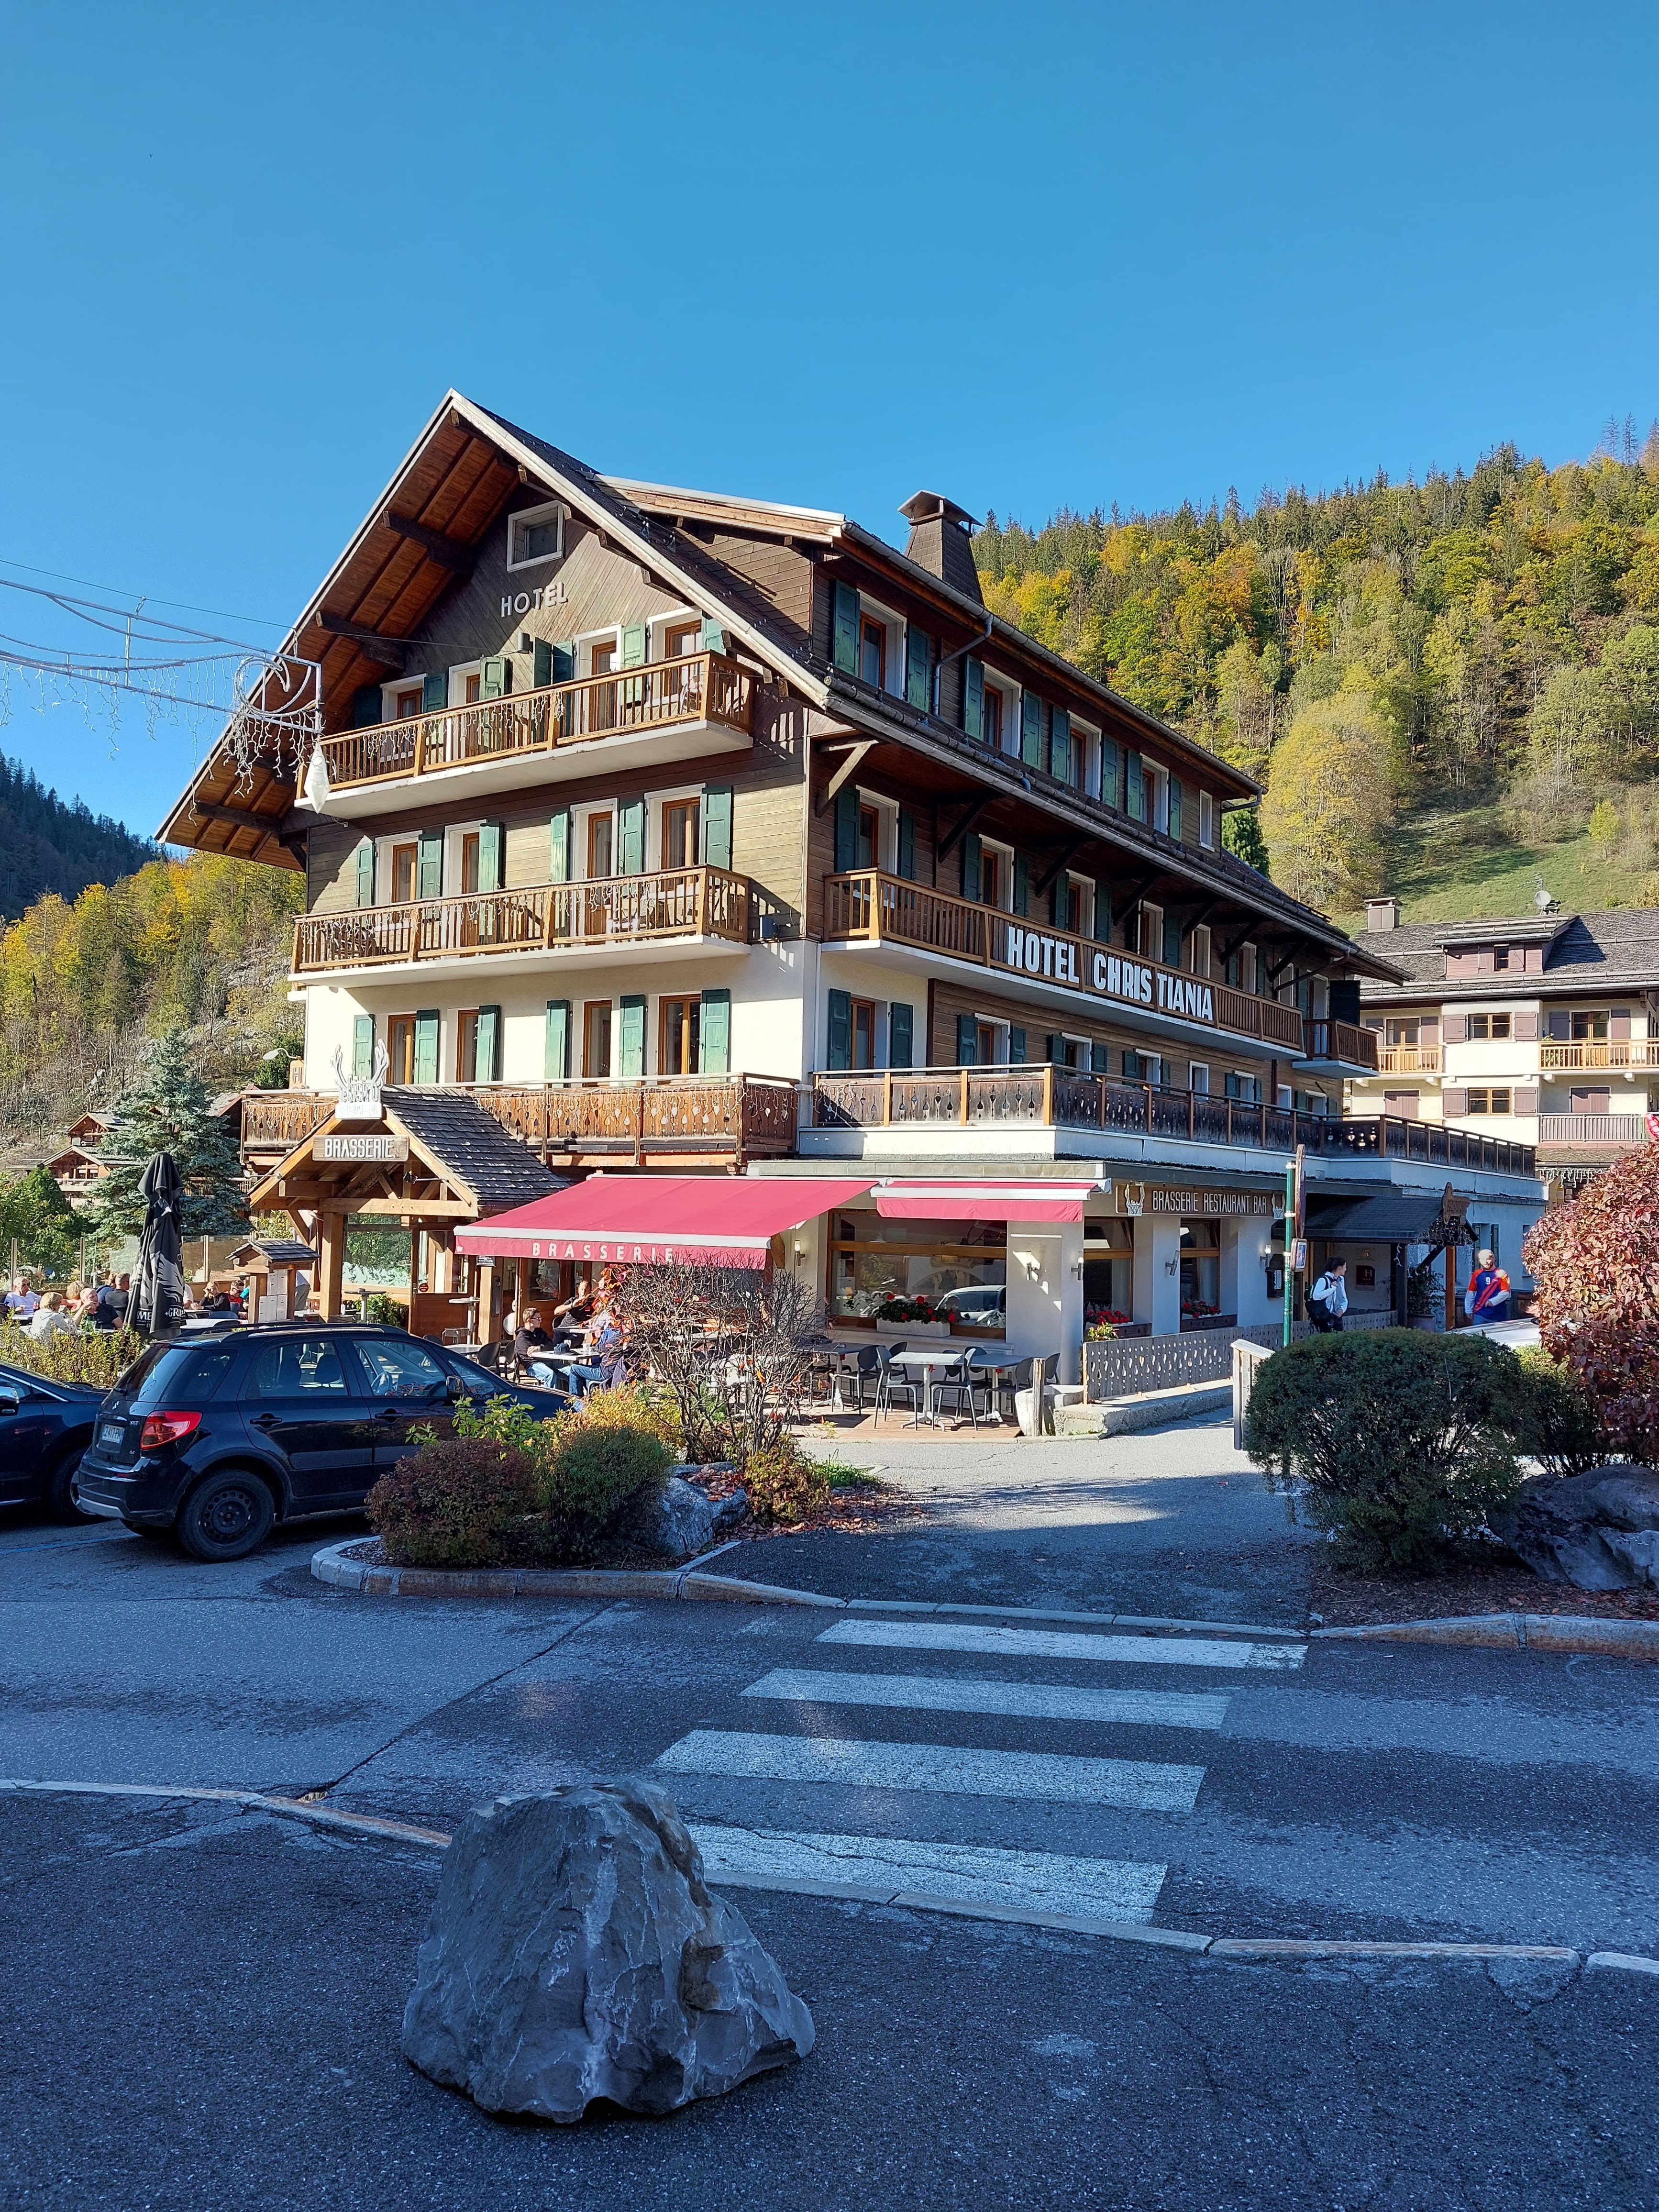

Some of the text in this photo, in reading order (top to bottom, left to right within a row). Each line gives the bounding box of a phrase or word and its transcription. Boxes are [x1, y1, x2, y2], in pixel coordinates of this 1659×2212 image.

[501, 582, 568, 618] HOTEL
[1008, 926, 1079, 984] HOTEL
[324, 1139, 394, 1158] BRASSERIE
[1153, 1190, 1198, 1212] BRASSERIE
[1204, 1193, 1250, 1214] RESTAURANT
[1253, 1196, 1267, 1214] BAR
[532, 1242, 673, 1262] BRASSERIE
[1485, 1277, 1491, 1285] 9
